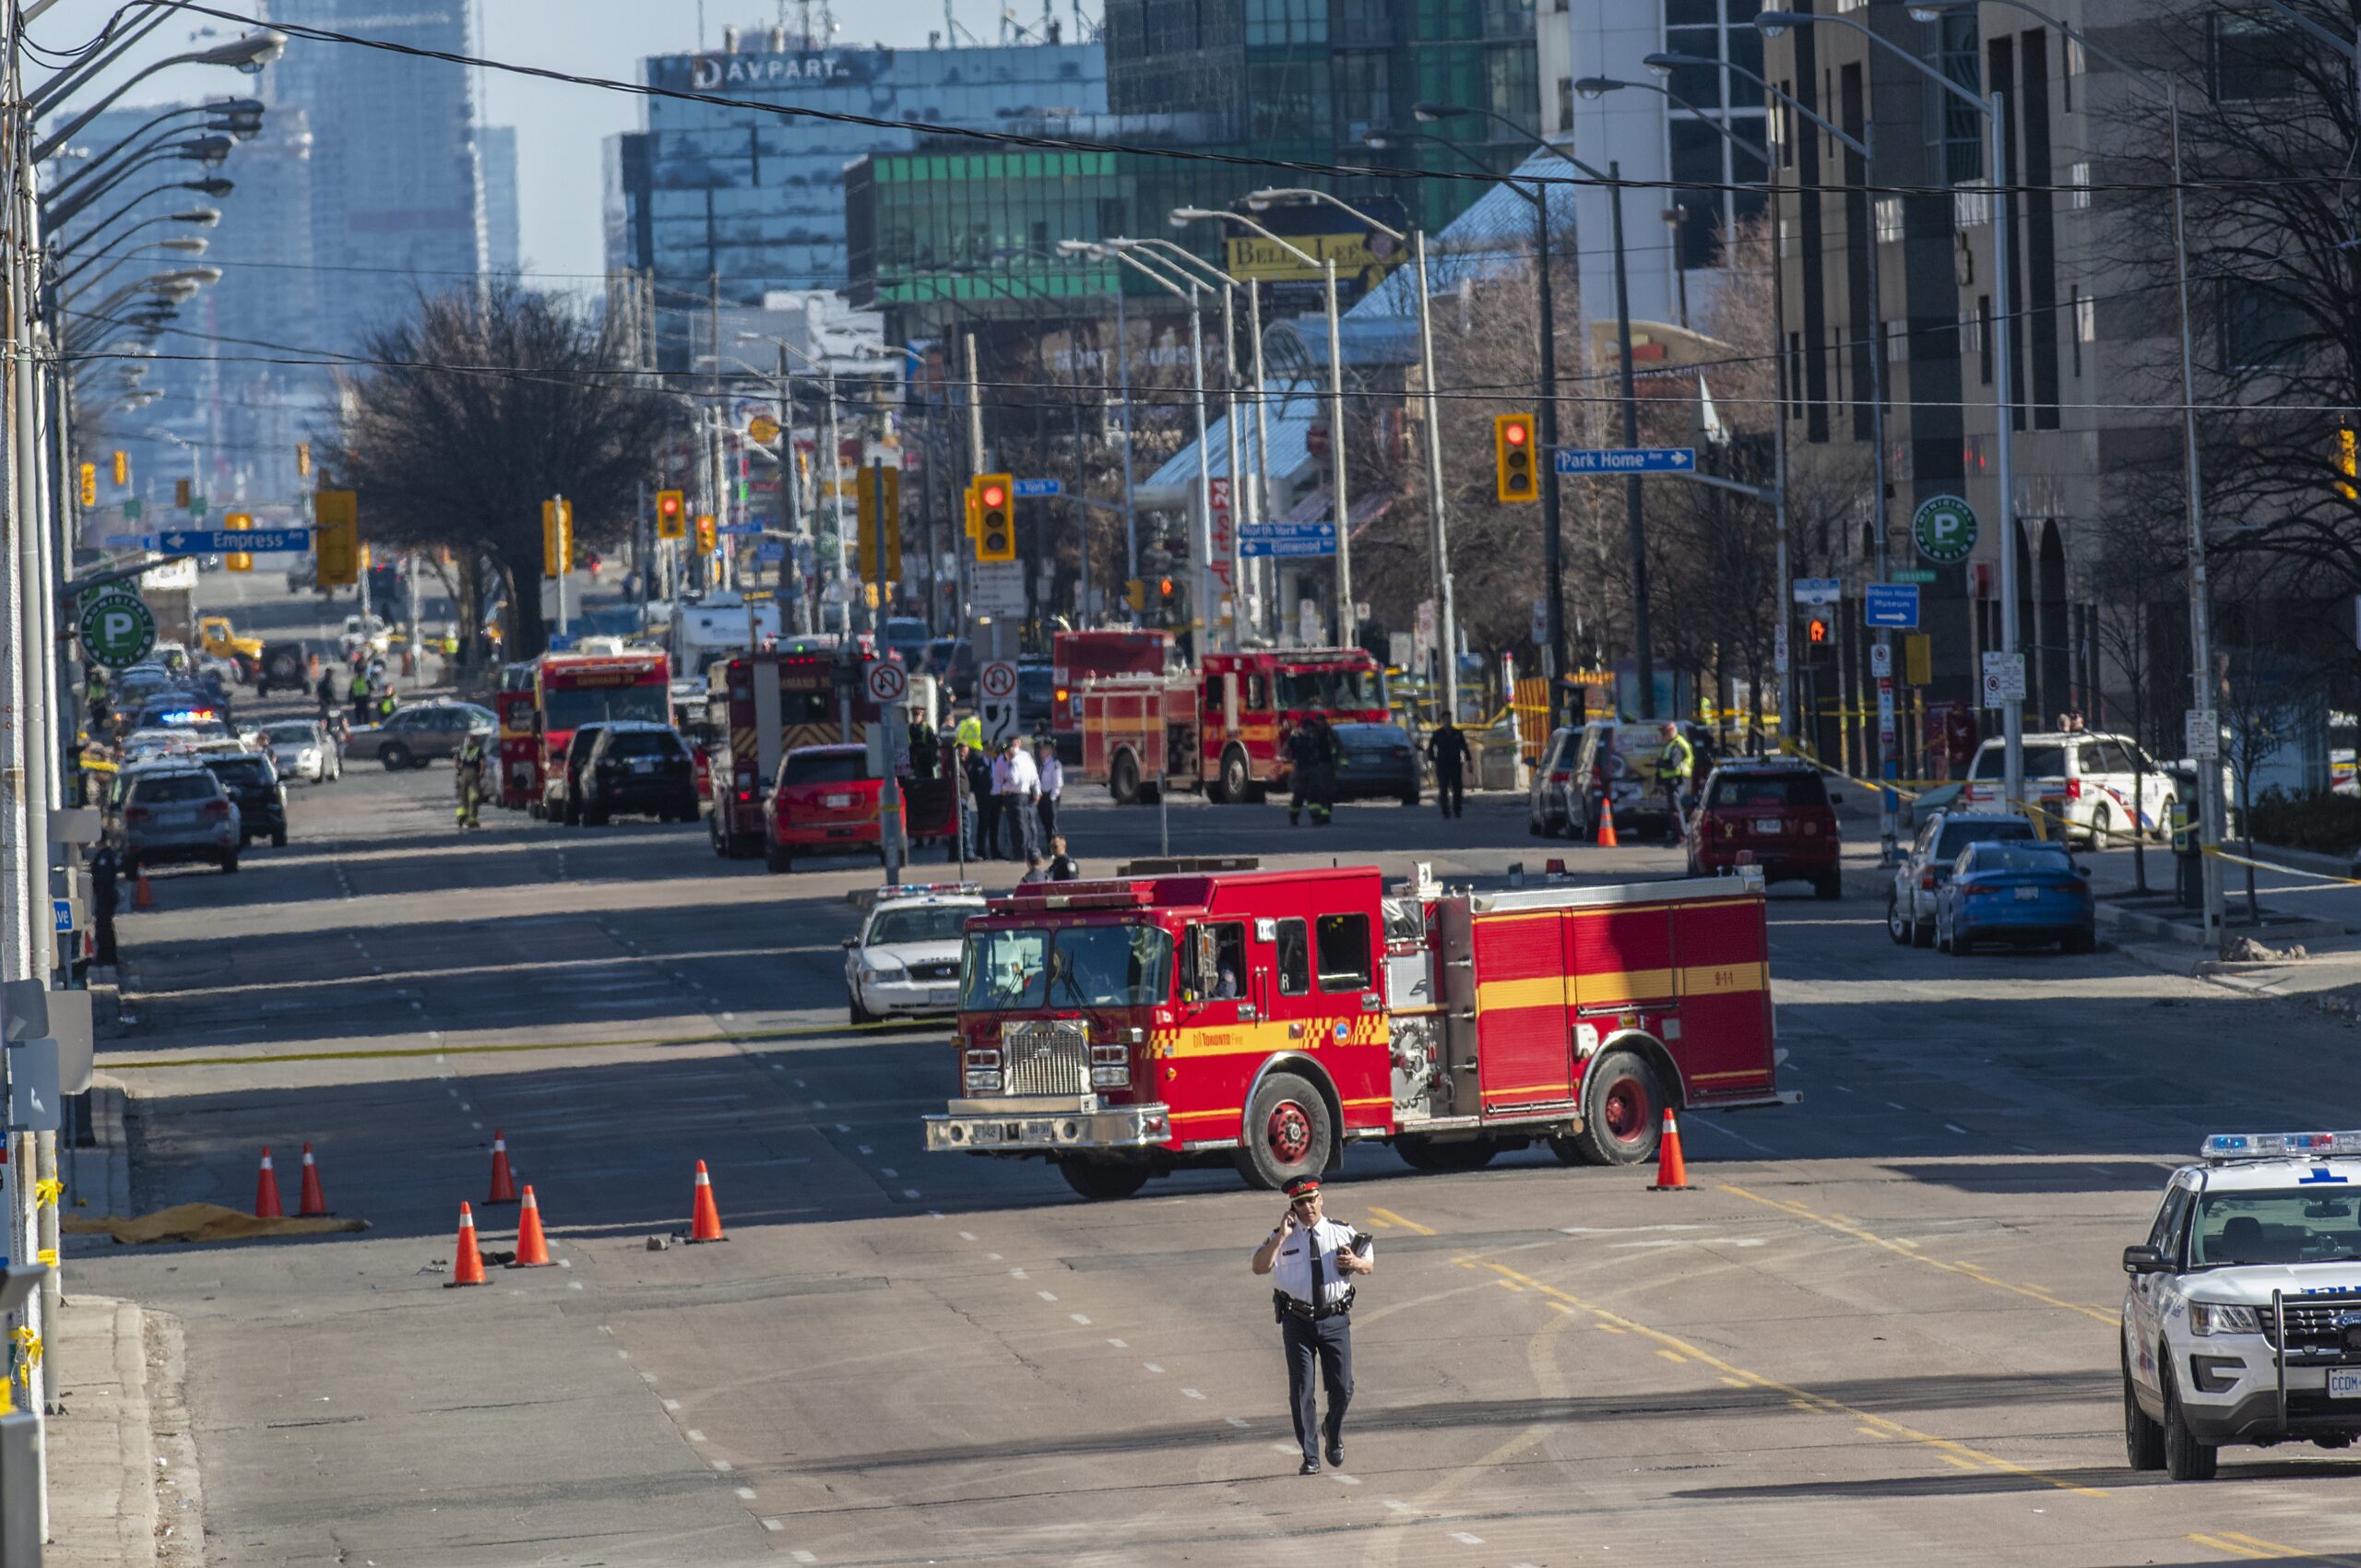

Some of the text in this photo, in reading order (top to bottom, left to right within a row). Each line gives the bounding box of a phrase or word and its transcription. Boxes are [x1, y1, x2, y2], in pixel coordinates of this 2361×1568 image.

[694, 58, 836, 89] DAVPART
[1561, 452, 1596, 471] Park
[1601, 451, 1645, 468] Home
[1935, 513, 1958, 540] P
[212, 532, 284, 549] Empress
[105, 612, 133, 644] P
